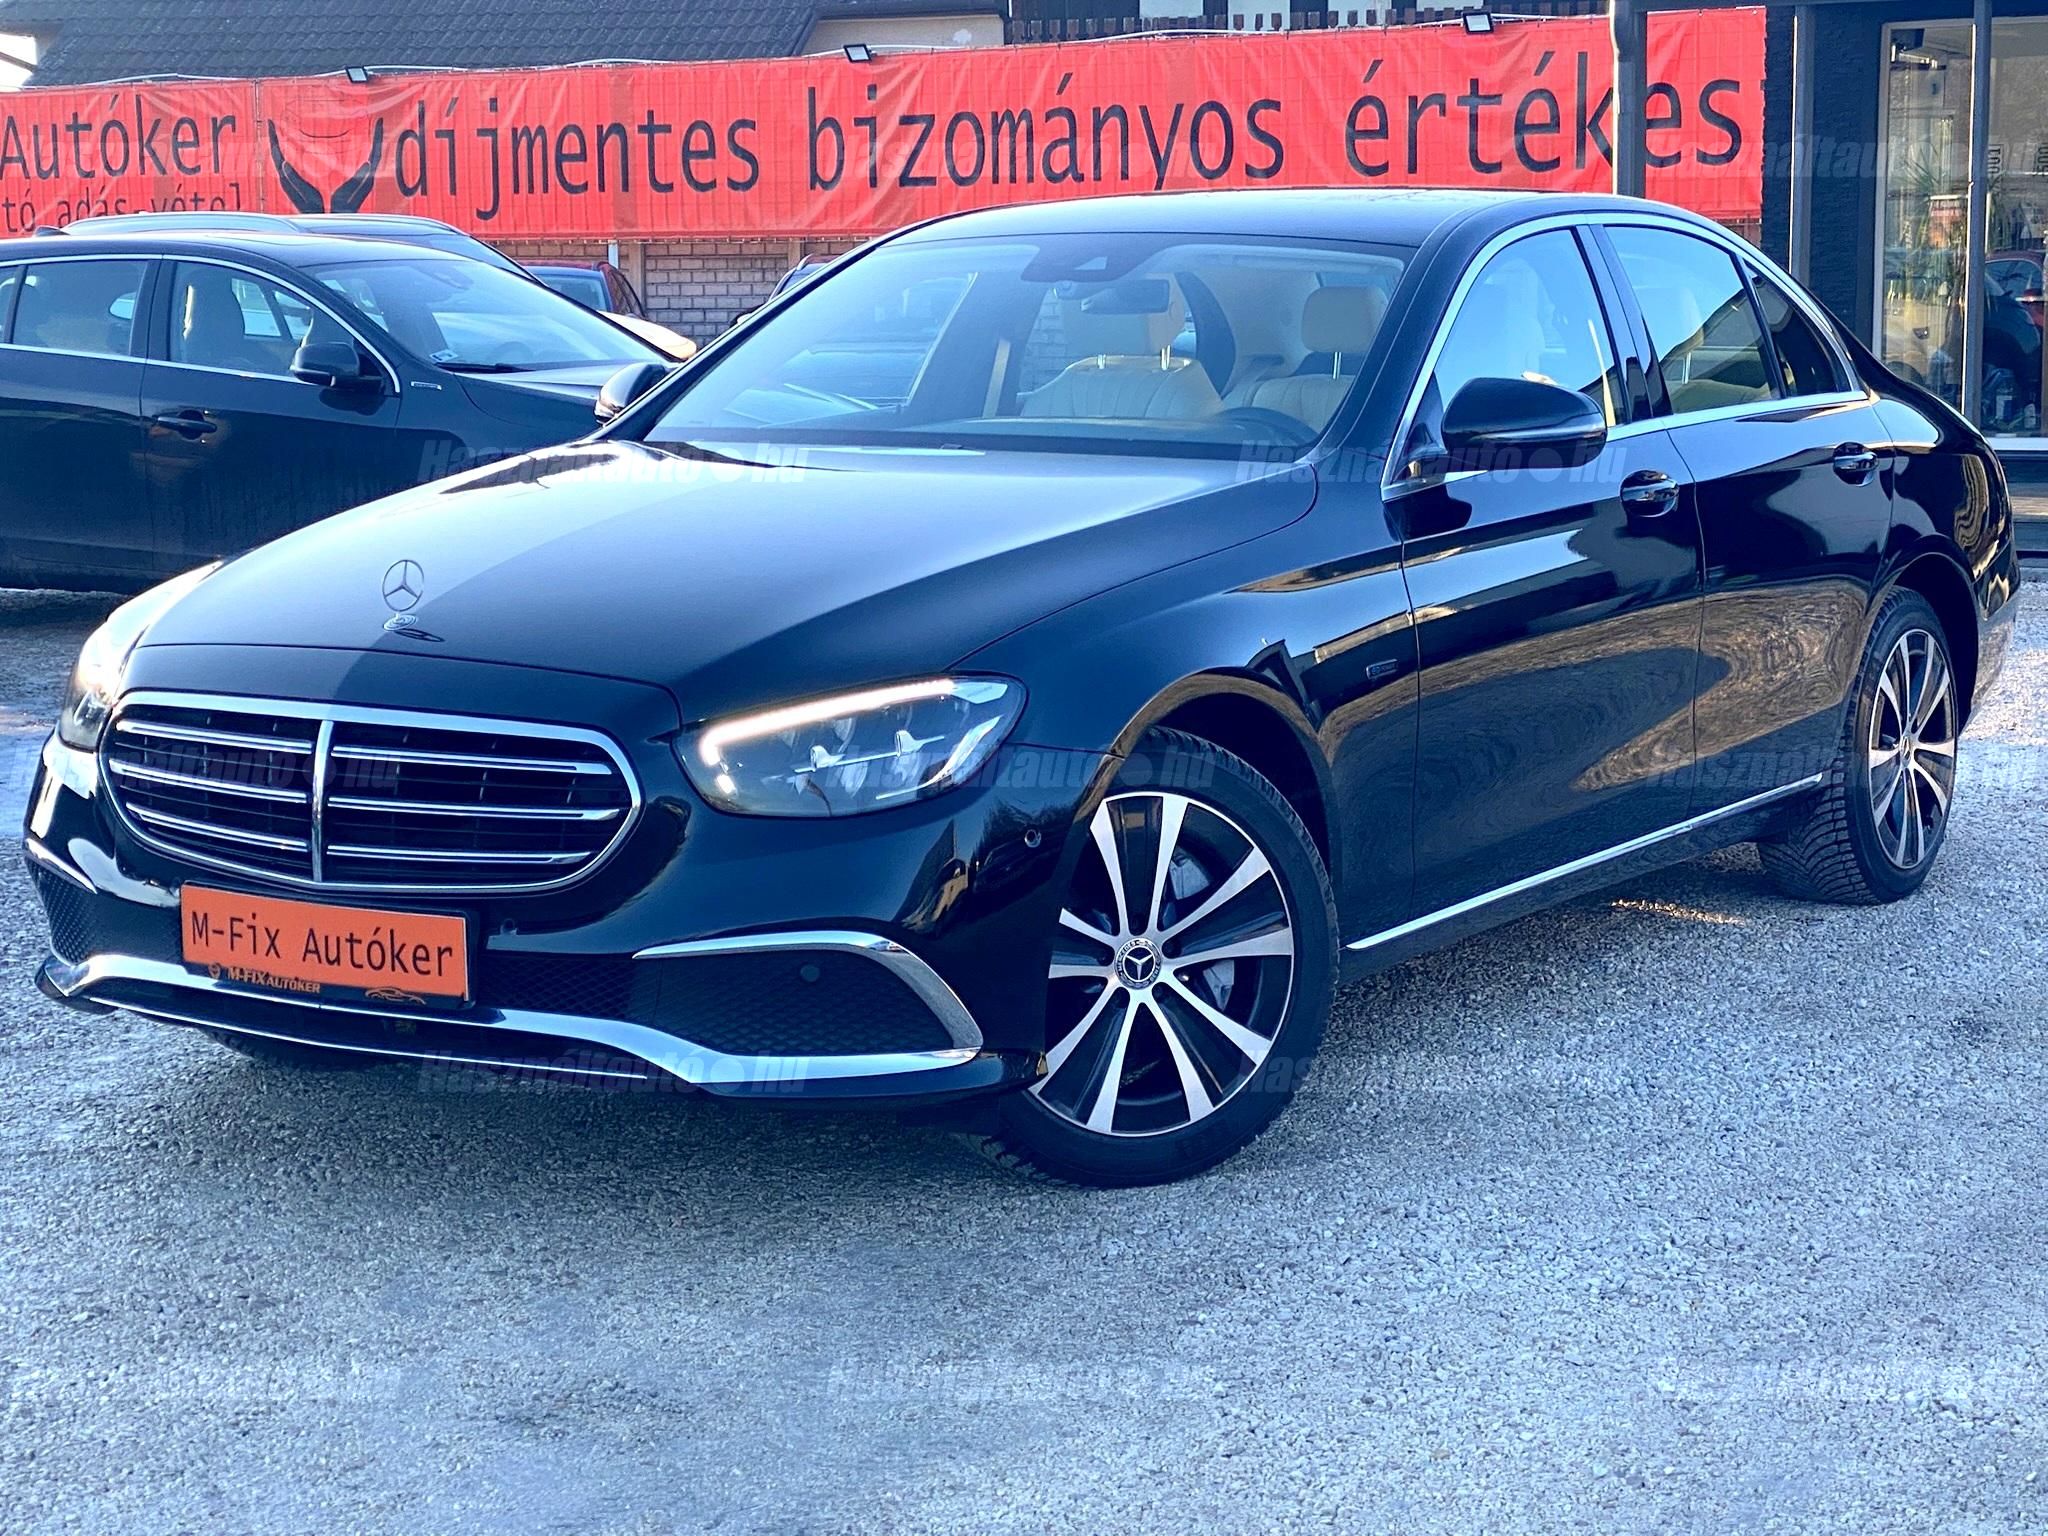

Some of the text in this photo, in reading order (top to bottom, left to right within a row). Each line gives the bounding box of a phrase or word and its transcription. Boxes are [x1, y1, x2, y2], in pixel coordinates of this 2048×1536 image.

[0, 94, 236, 180] Autóker
[395, 50, 1742, 220] díjmentes bizományos értékes
[191, 911, 453, 977] M-Fix Autóker
[227, 966, 267, 985] M-FIX
